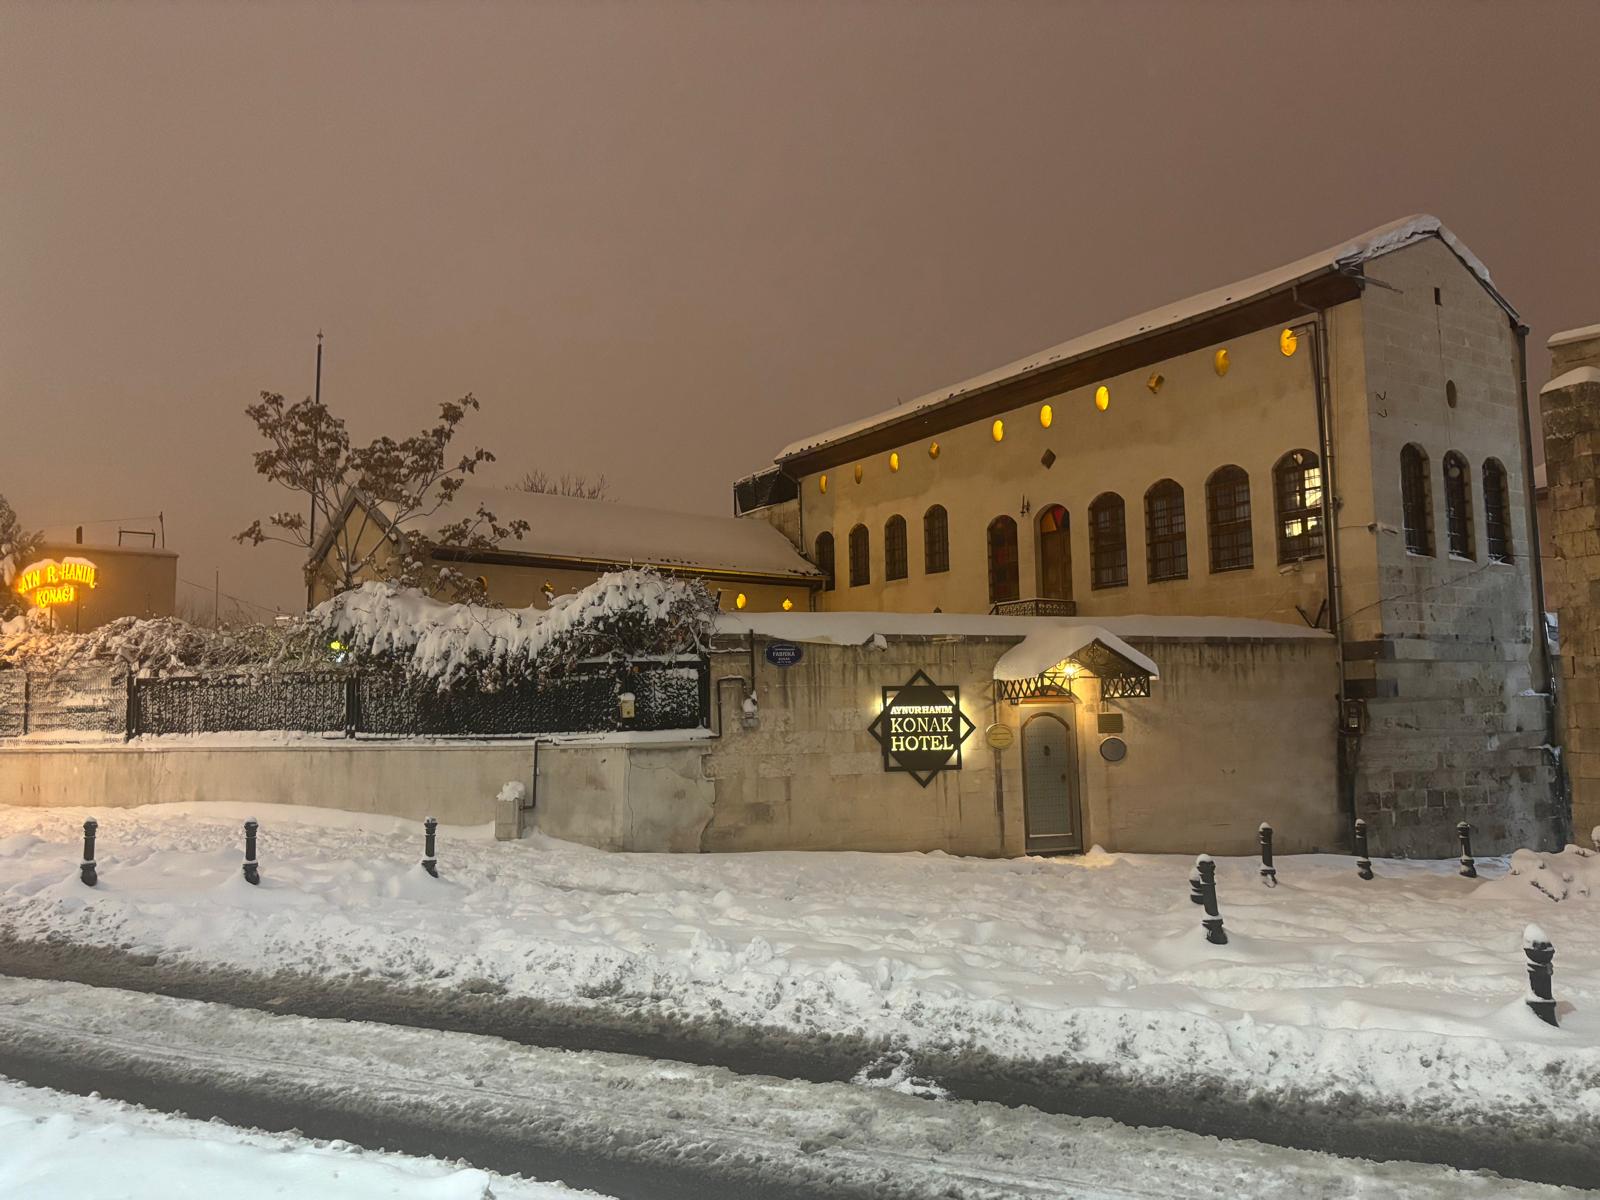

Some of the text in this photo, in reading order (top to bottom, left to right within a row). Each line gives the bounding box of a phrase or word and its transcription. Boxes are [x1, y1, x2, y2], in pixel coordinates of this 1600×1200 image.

[60, 563, 96, 588] HANIM
[890, 717, 953, 733] KONAK
[891, 735, 954, 751] HOTEL
